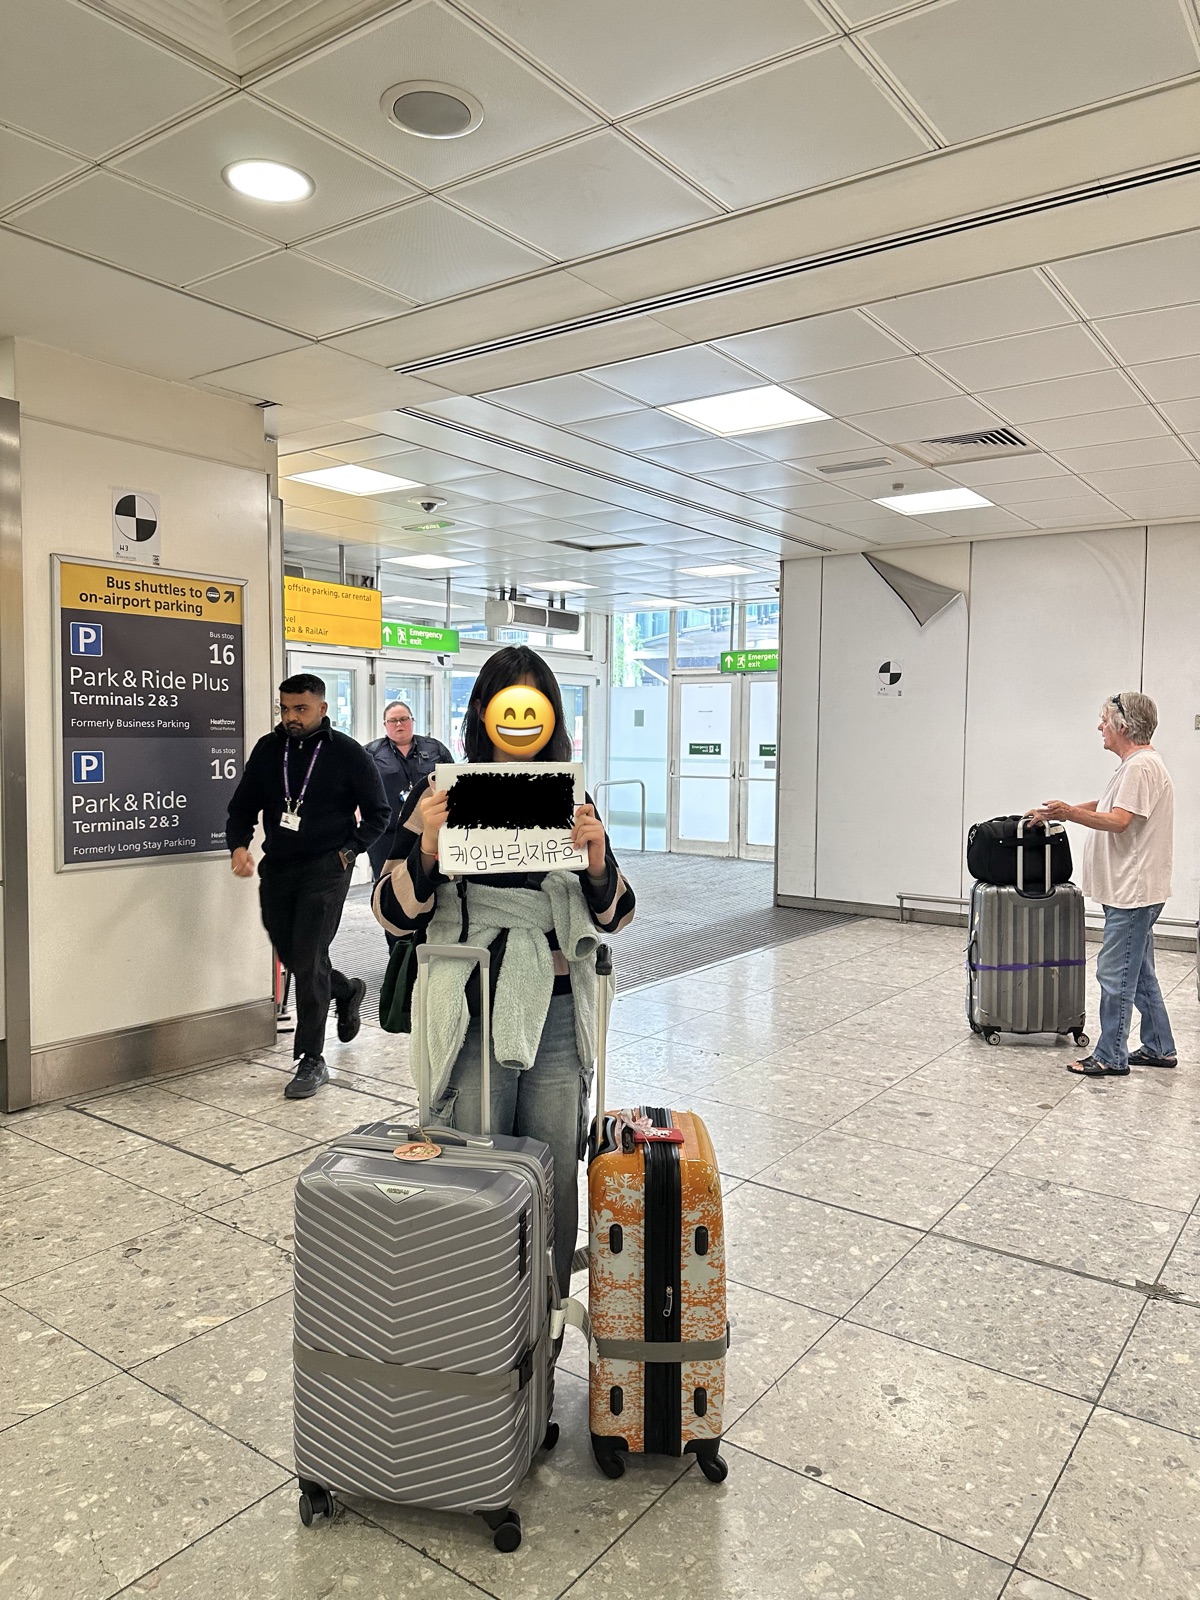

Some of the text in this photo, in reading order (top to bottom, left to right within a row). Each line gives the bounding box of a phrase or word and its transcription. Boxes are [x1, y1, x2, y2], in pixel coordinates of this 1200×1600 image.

[106, 576, 202, 598] Bus shuttles to
[288, 584, 310, 593] offsite
[312, 588, 340, 598] parking,
[352, 594, 372, 602] rental
[79, 592, 203, 616] on-airport parking
[79, 626, 97, 652] P
[306, 627, 328, 636] RailAir
[410, 628, 443, 640] Emergency
[209, 644, 235, 666] 16
[70, 666, 229, 692] Park & Ride Plus
[70, 692, 144, 707] Terminals
[71, 718, 190, 730] Formerly Business Parking
[81, 755, 98, 780] P
[210, 758, 237, 780] 16
[72, 791, 187, 814] Park & Ride
[73, 817, 146, 834] Terminals
[73, 838, 196, 855] Formerly Long Stay Parking
